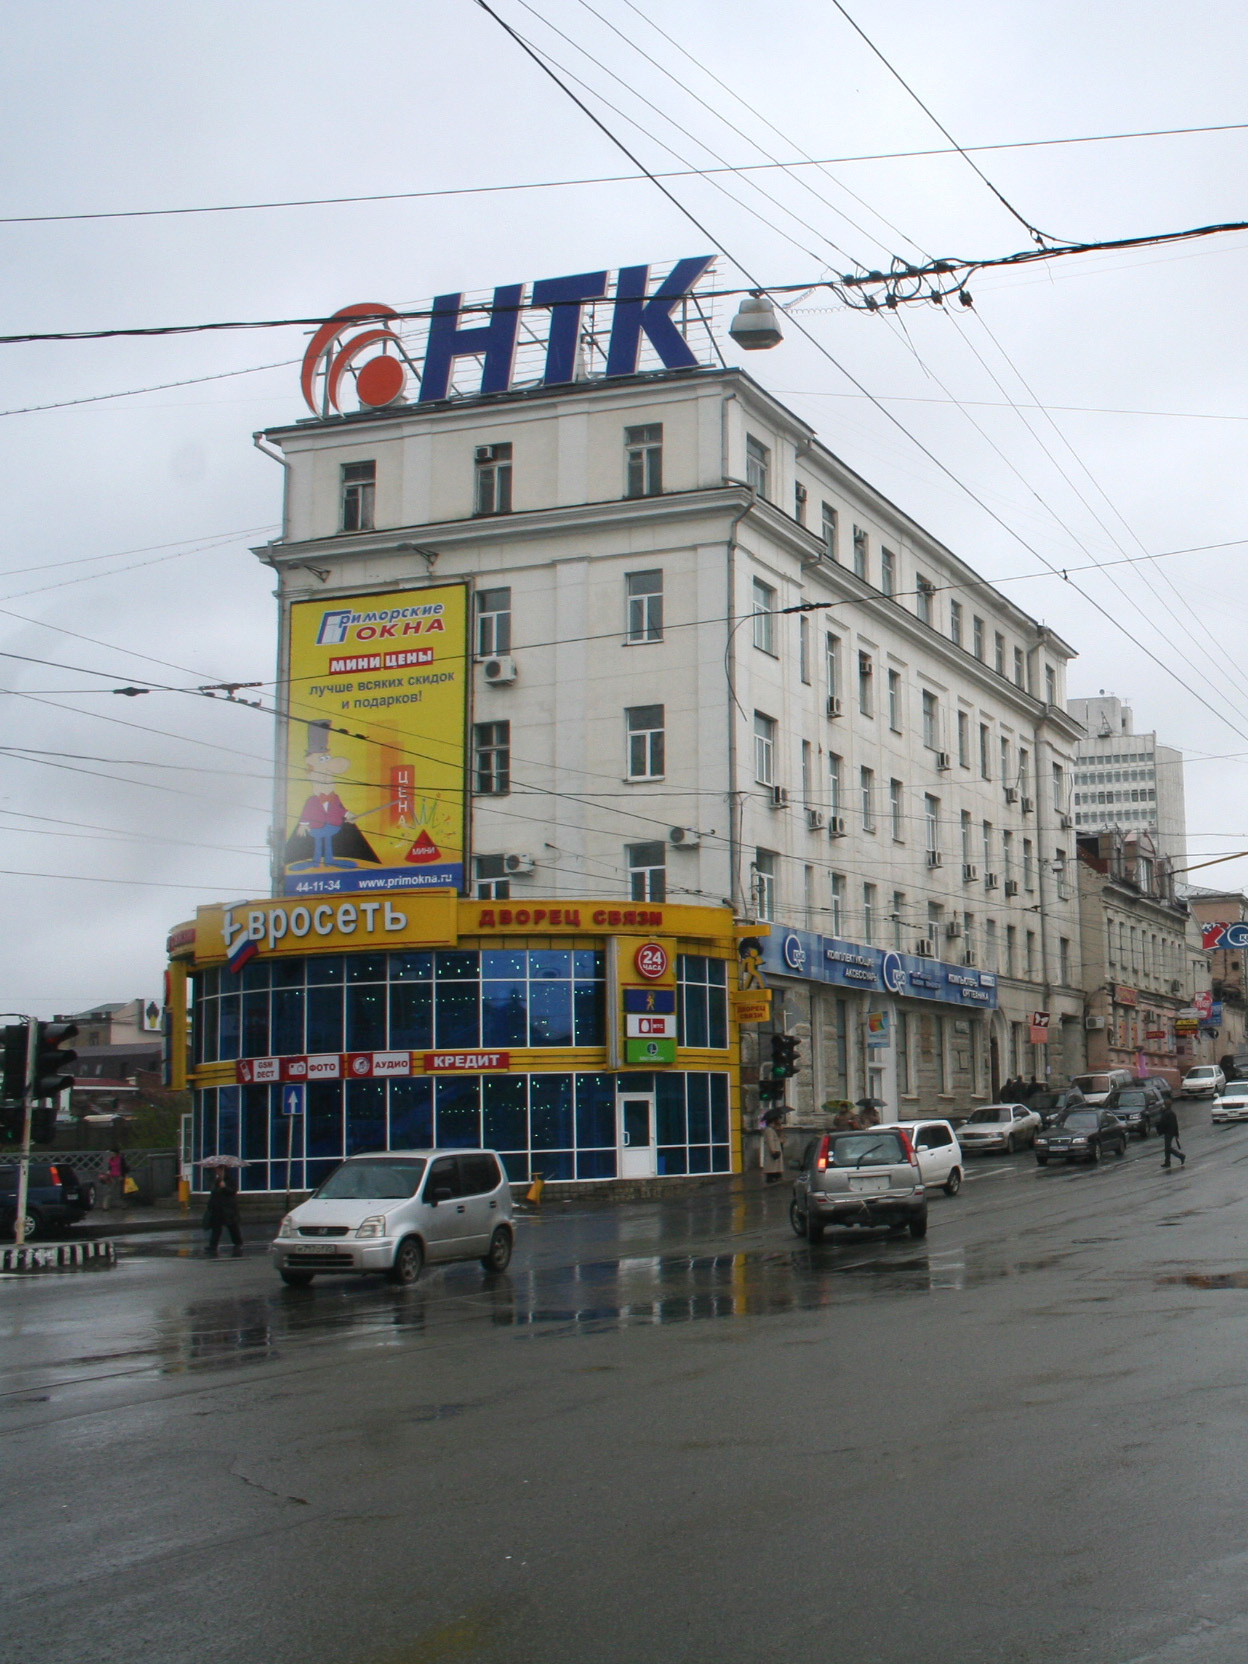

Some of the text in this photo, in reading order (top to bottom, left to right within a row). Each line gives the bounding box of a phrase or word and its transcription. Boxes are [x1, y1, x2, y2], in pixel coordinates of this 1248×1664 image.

[418, 254, 718, 402] НТК
[316, 603, 444, 645] Приморские
[355, 618, 445, 641] ОКНА
[330, 650, 433, 672] МИНИ ЦЕНЫ
[309, 671, 455, 698] лучше всяких скидок
[342, 690, 422, 709] и подарков!
[398, 770, 408, 825] ЦЕНА
[412, 847, 435, 855] МИНИ
[295, 879, 341, 892] 44-11-34
[358, 874, 453, 889] www.primokna.ru
[479, 909, 663, 928] ДВОРЕЦ СВЯЗИ
[643, 950, 663, 964] 24
[258, 1060, 273, 1069] GSM
[309, 1063, 336, 1072] ФОТО
[374, 1060, 409, 1069] АУДИО
[434, 1054, 500, 1068] КРЕДИТ
[257, 1070, 275, 1079] DECT
